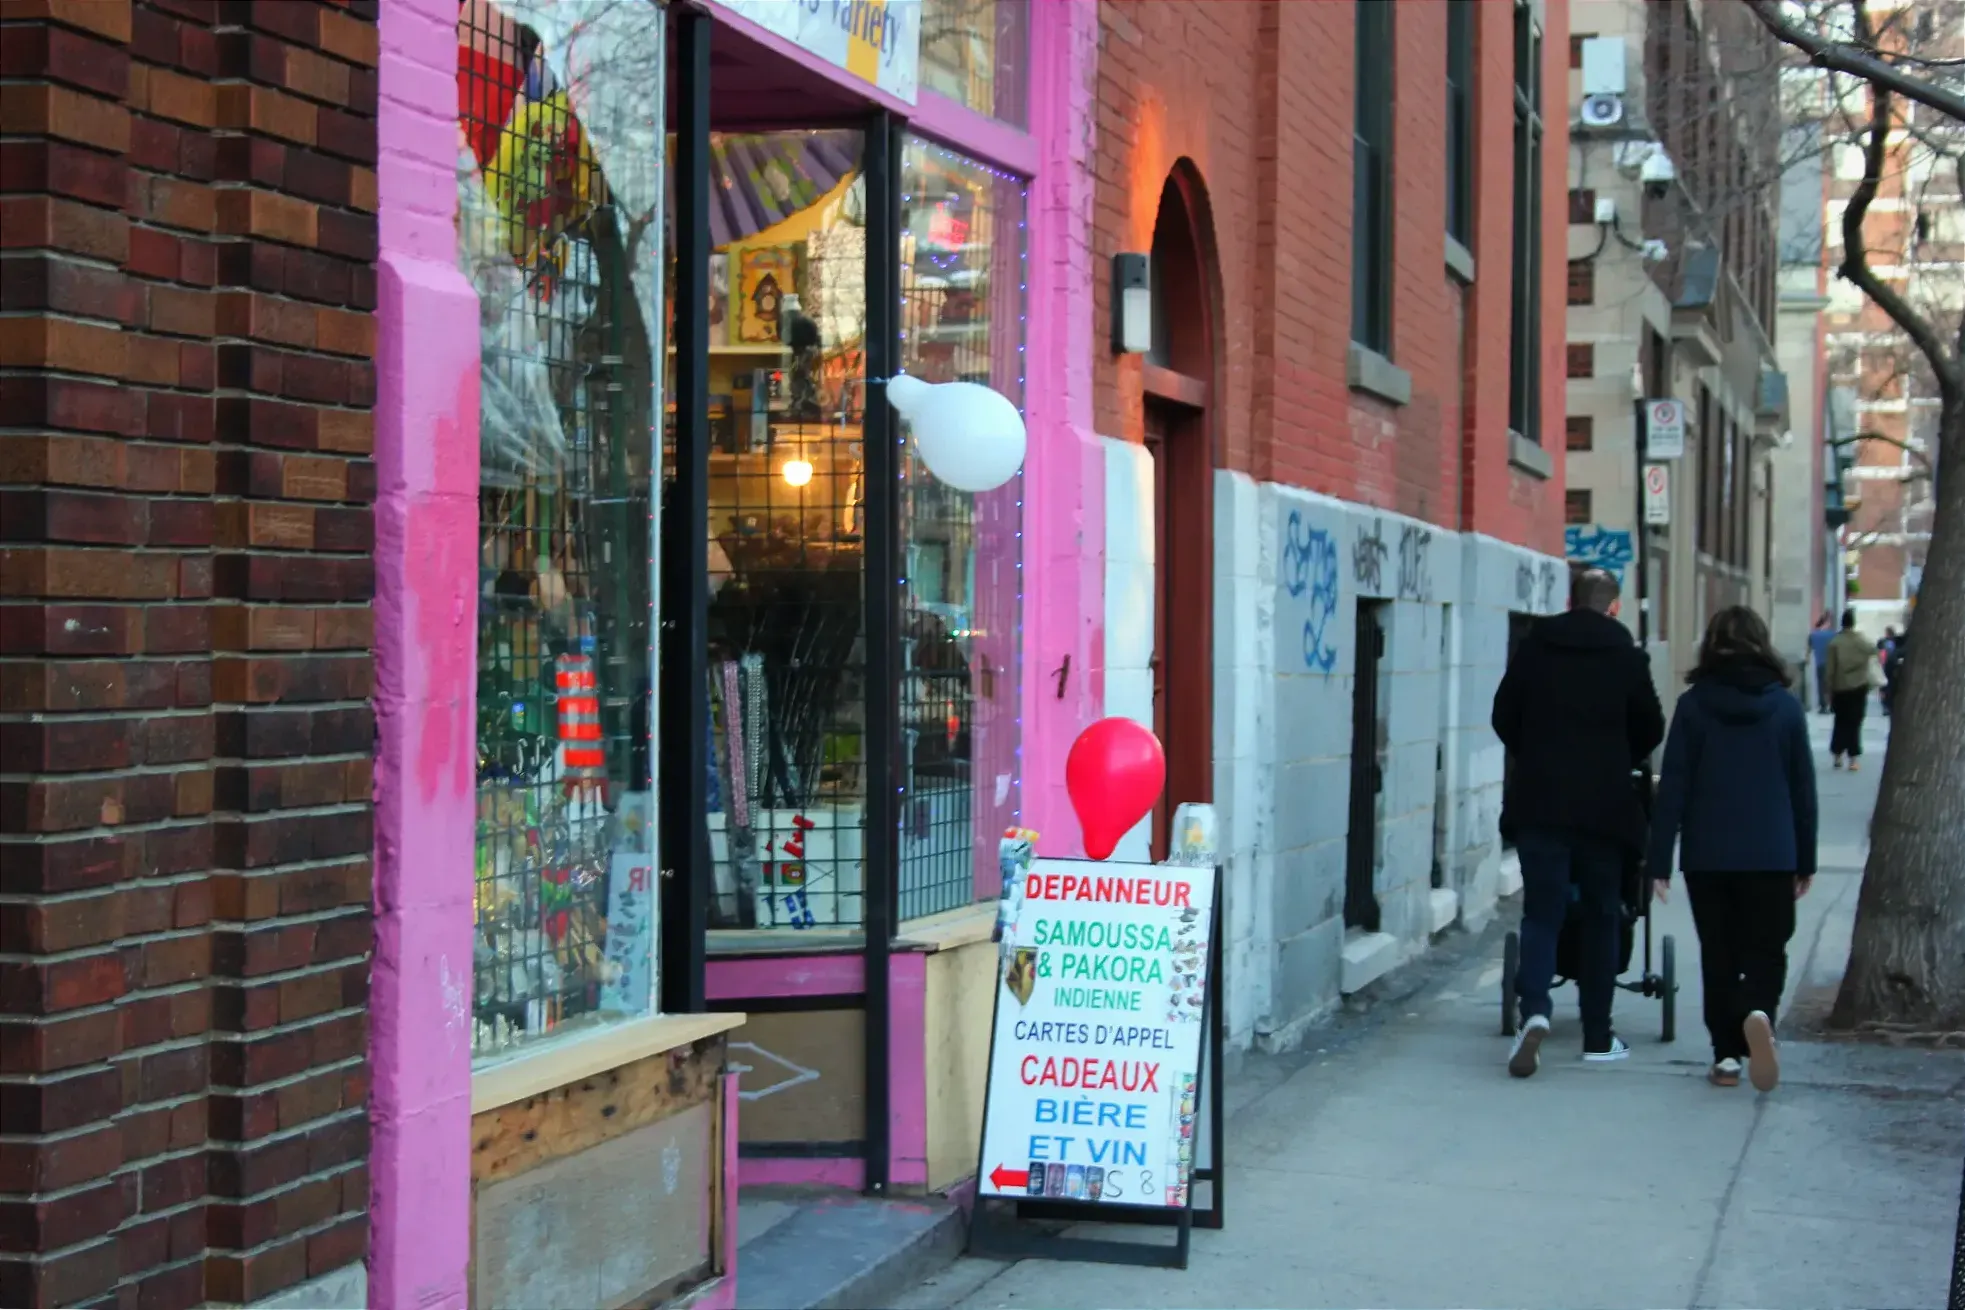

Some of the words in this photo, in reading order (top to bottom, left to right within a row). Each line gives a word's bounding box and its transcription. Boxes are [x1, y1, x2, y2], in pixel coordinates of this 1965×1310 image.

[1025, 874, 1191, 907] DEPANNEUR
[1033, 918, 1171, 951] SAMOUSSA
[1037, 951, 1053, 978] &
[1061, 952, 1163, 985] PAKORA
[1053, 986, 1142, 1012] INDIENNE
[1014, 1020, 1089, 1044] CARTES
[1095, 1024, 1175, 1050] D'APPEL
[1020, 1054, 1160, 1093] CADEAUX
[1035, 1095, 1147, 1129] BIÈRE
[1028, 1135, 1075, 1161] ET
[1085, 1138, 1147, 1167] VIN
